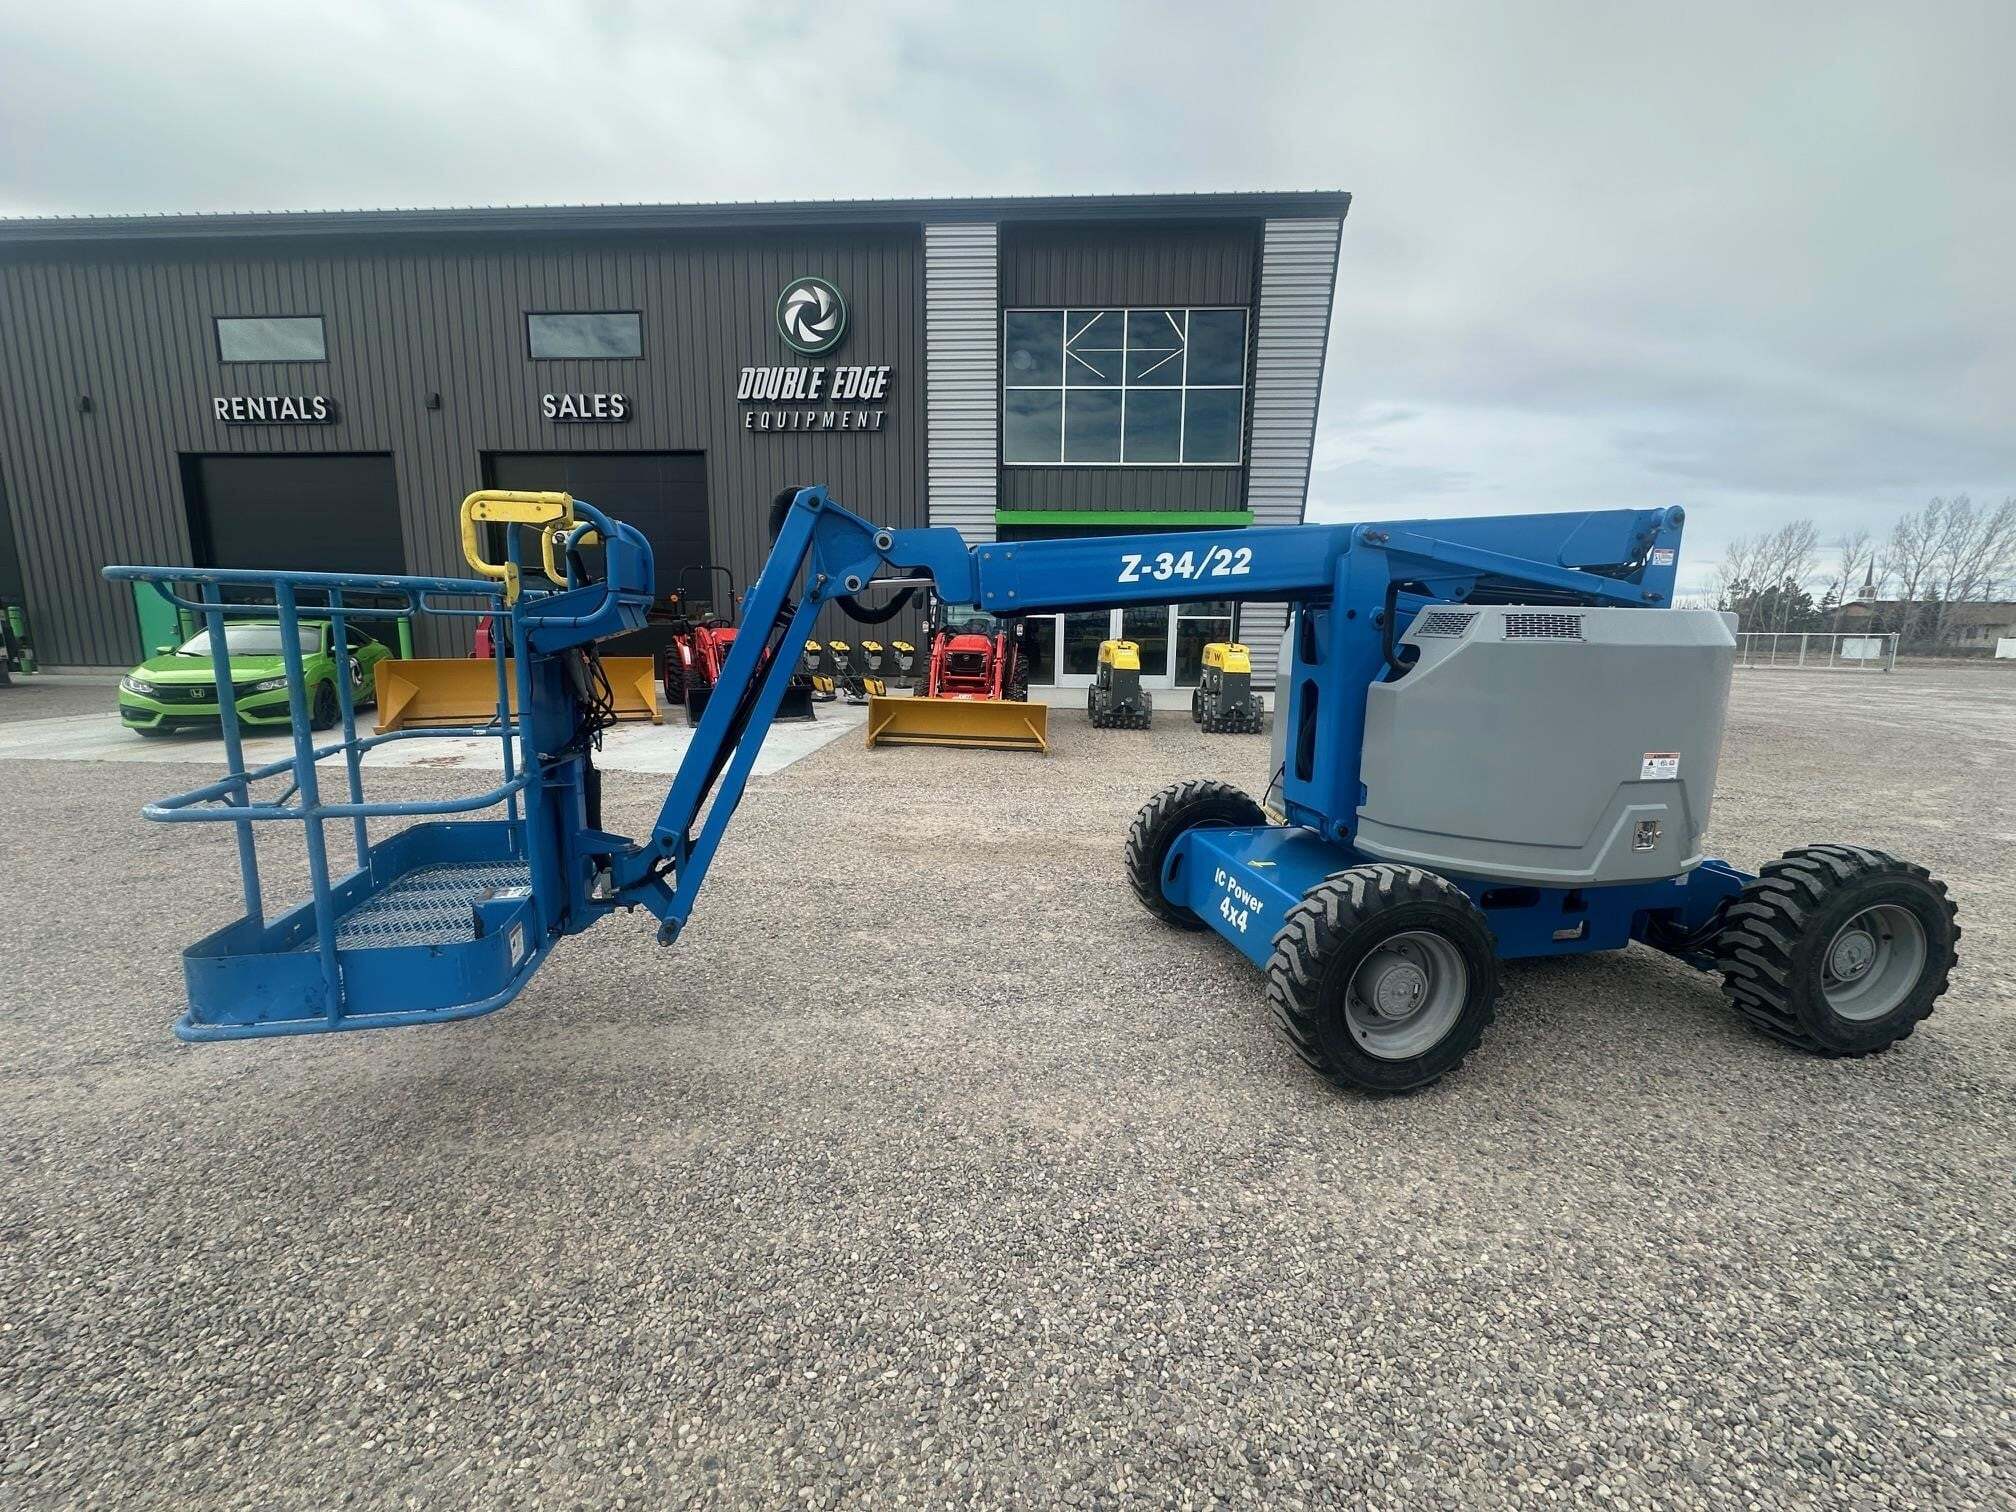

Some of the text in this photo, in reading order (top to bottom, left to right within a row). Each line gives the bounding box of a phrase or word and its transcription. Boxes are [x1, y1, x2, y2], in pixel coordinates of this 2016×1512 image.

[737, 366, 891, 400] DOUBLE EDGE
[213, 396, 327, 420] RENTALS
[543, 393, 624, 418] SALES
[745, 411, 884, 429] EQUIPMENT
[1118, 545, 1252, 583] Z-34/22
[1214, 867, 1264, 914] IC Power
